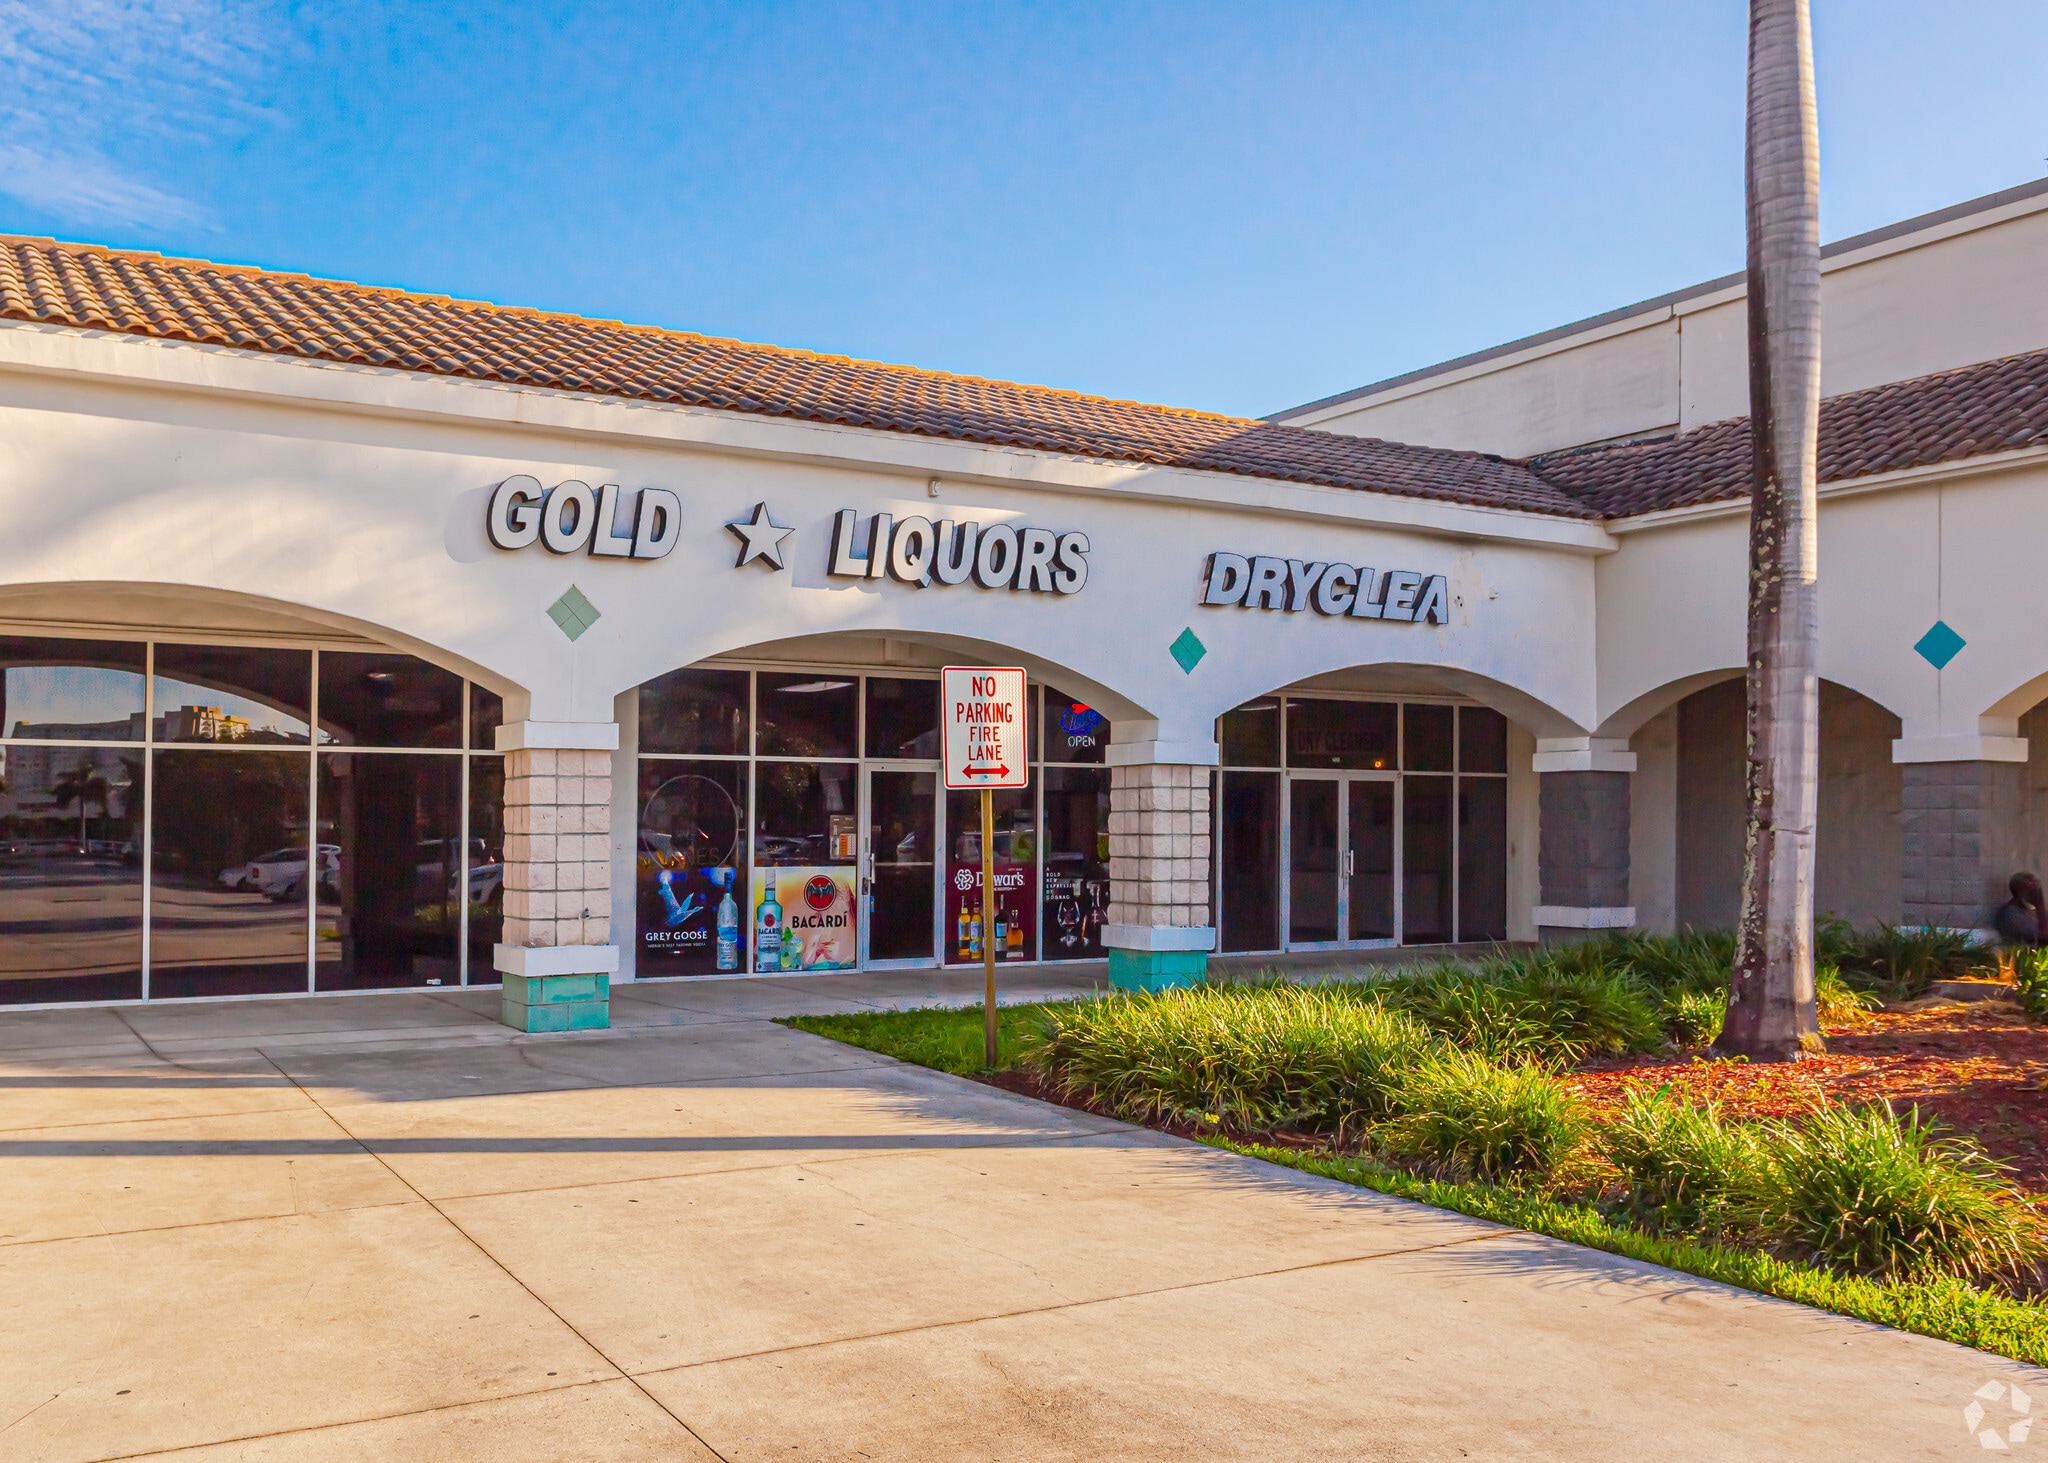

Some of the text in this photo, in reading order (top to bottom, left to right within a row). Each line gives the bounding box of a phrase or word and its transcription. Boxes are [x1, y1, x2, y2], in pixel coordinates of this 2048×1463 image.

[486, 474, 1090, 595] GOLD LIQUORS
[1199, 551, 1449, 625] DRYCLEA
[972, 676, 996, 697] NO
[956, 702, 1013, 723] PARKING
[970, 726, 1001, 742] FIRE
[1067, 735, 1096, 747] OPEN
[968, 745, 1003, 761] LANE
[975, 870, 1024, 887] Dwar's
[791, 910, 848, 929] BACARDÍ
[645, 930, 708, 941] GREY GOOSE
